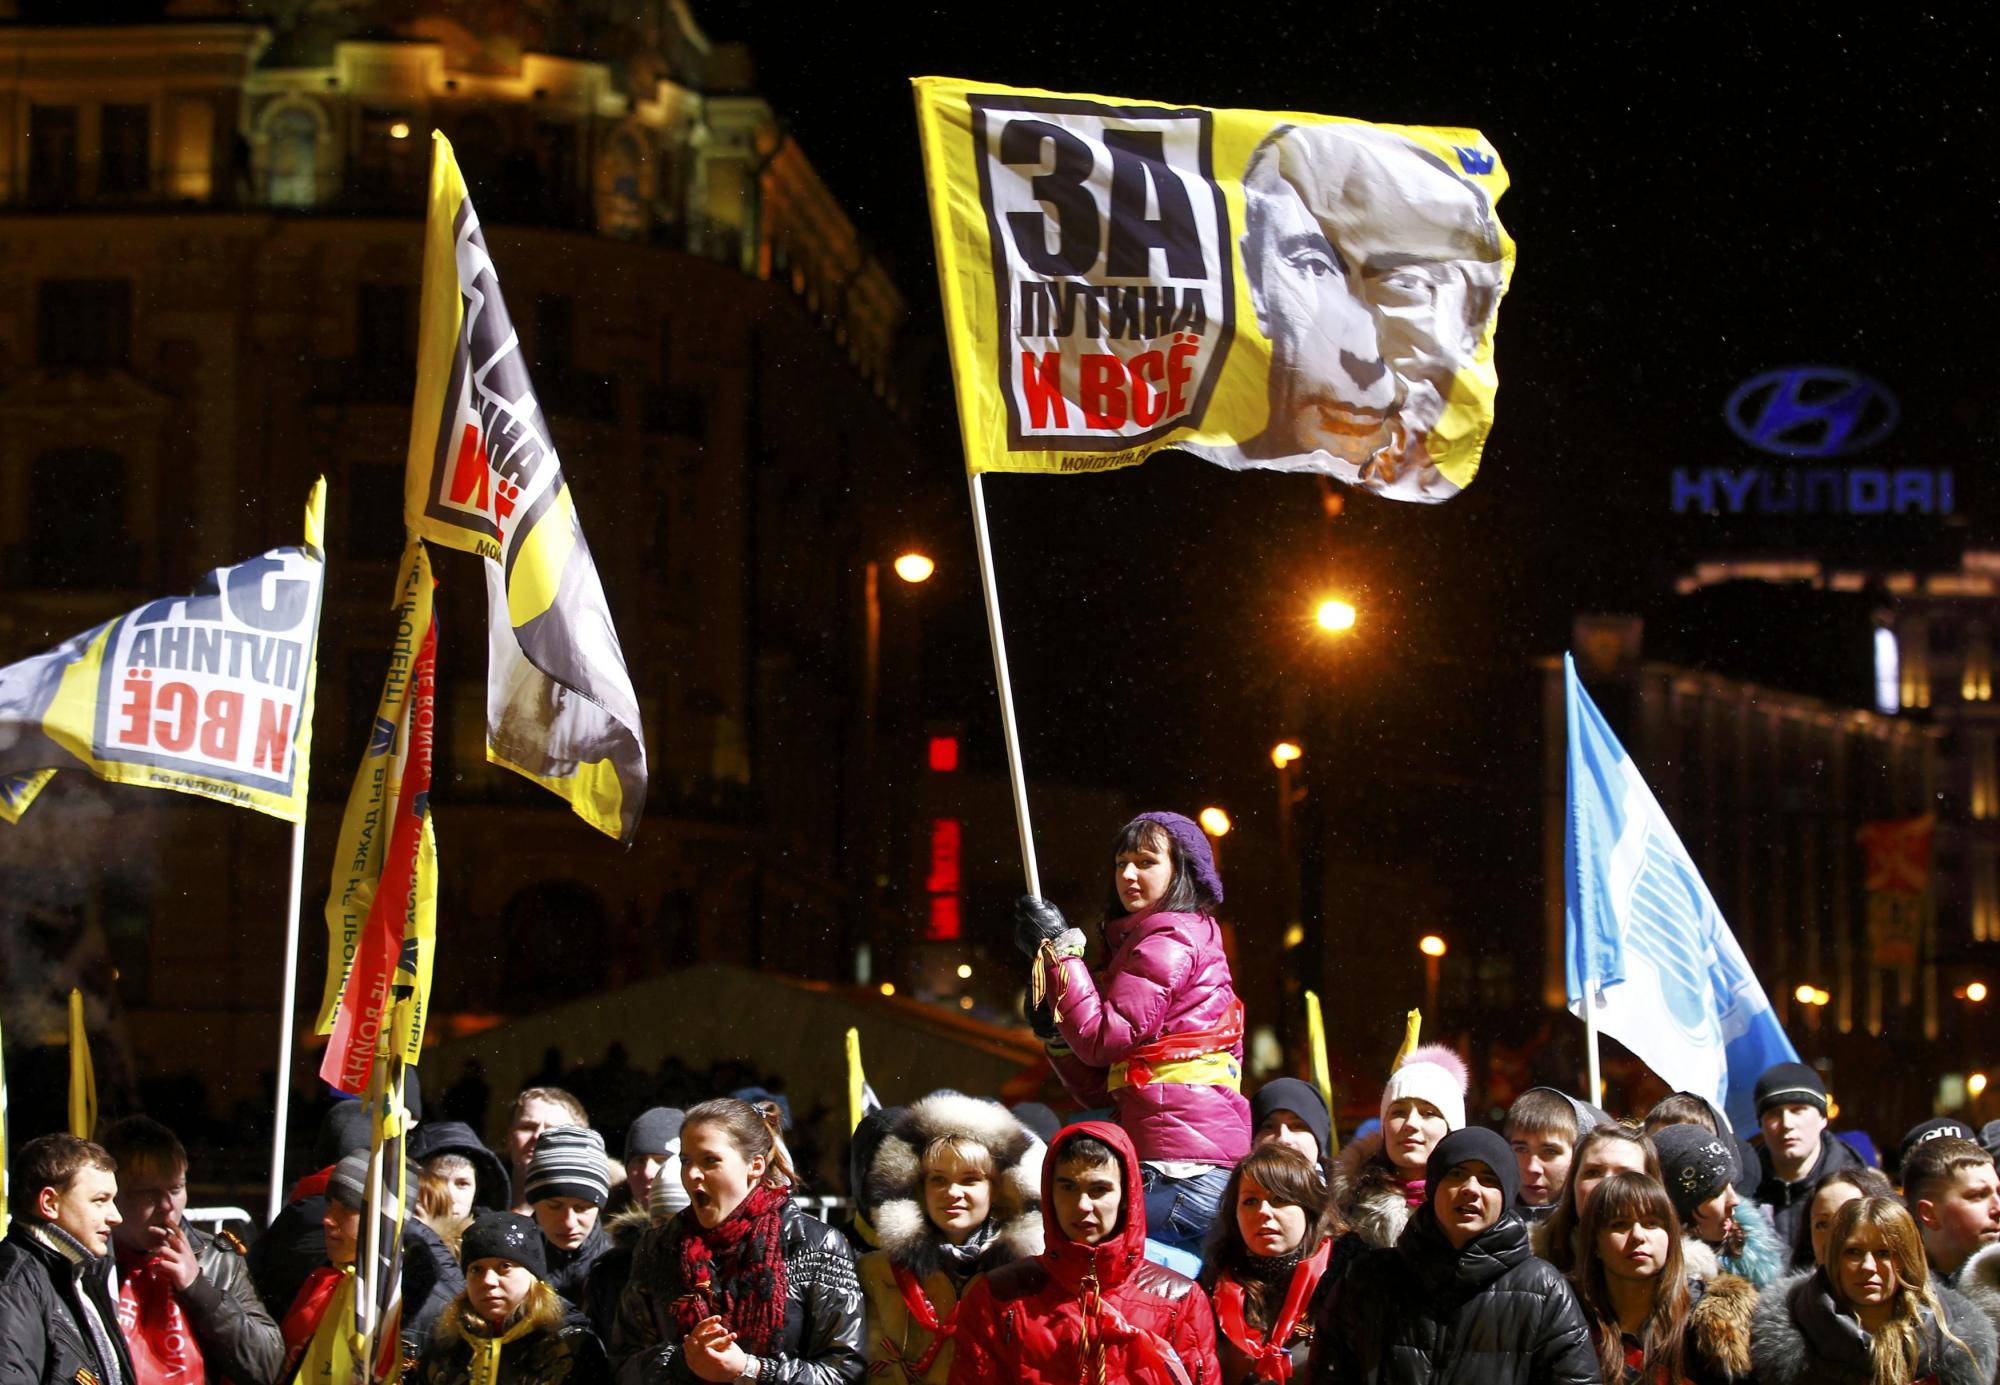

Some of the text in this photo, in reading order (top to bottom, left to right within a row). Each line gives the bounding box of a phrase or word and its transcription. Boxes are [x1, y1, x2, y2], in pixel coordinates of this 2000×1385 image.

[1000, 119, 1208, 280] ЗА
[1021, 281, 1206, 340] ПУТИНА
[1021, 332, 1200, 431] И ВСЁ
[1671, 468, 1954, 513] HYUNDAI
